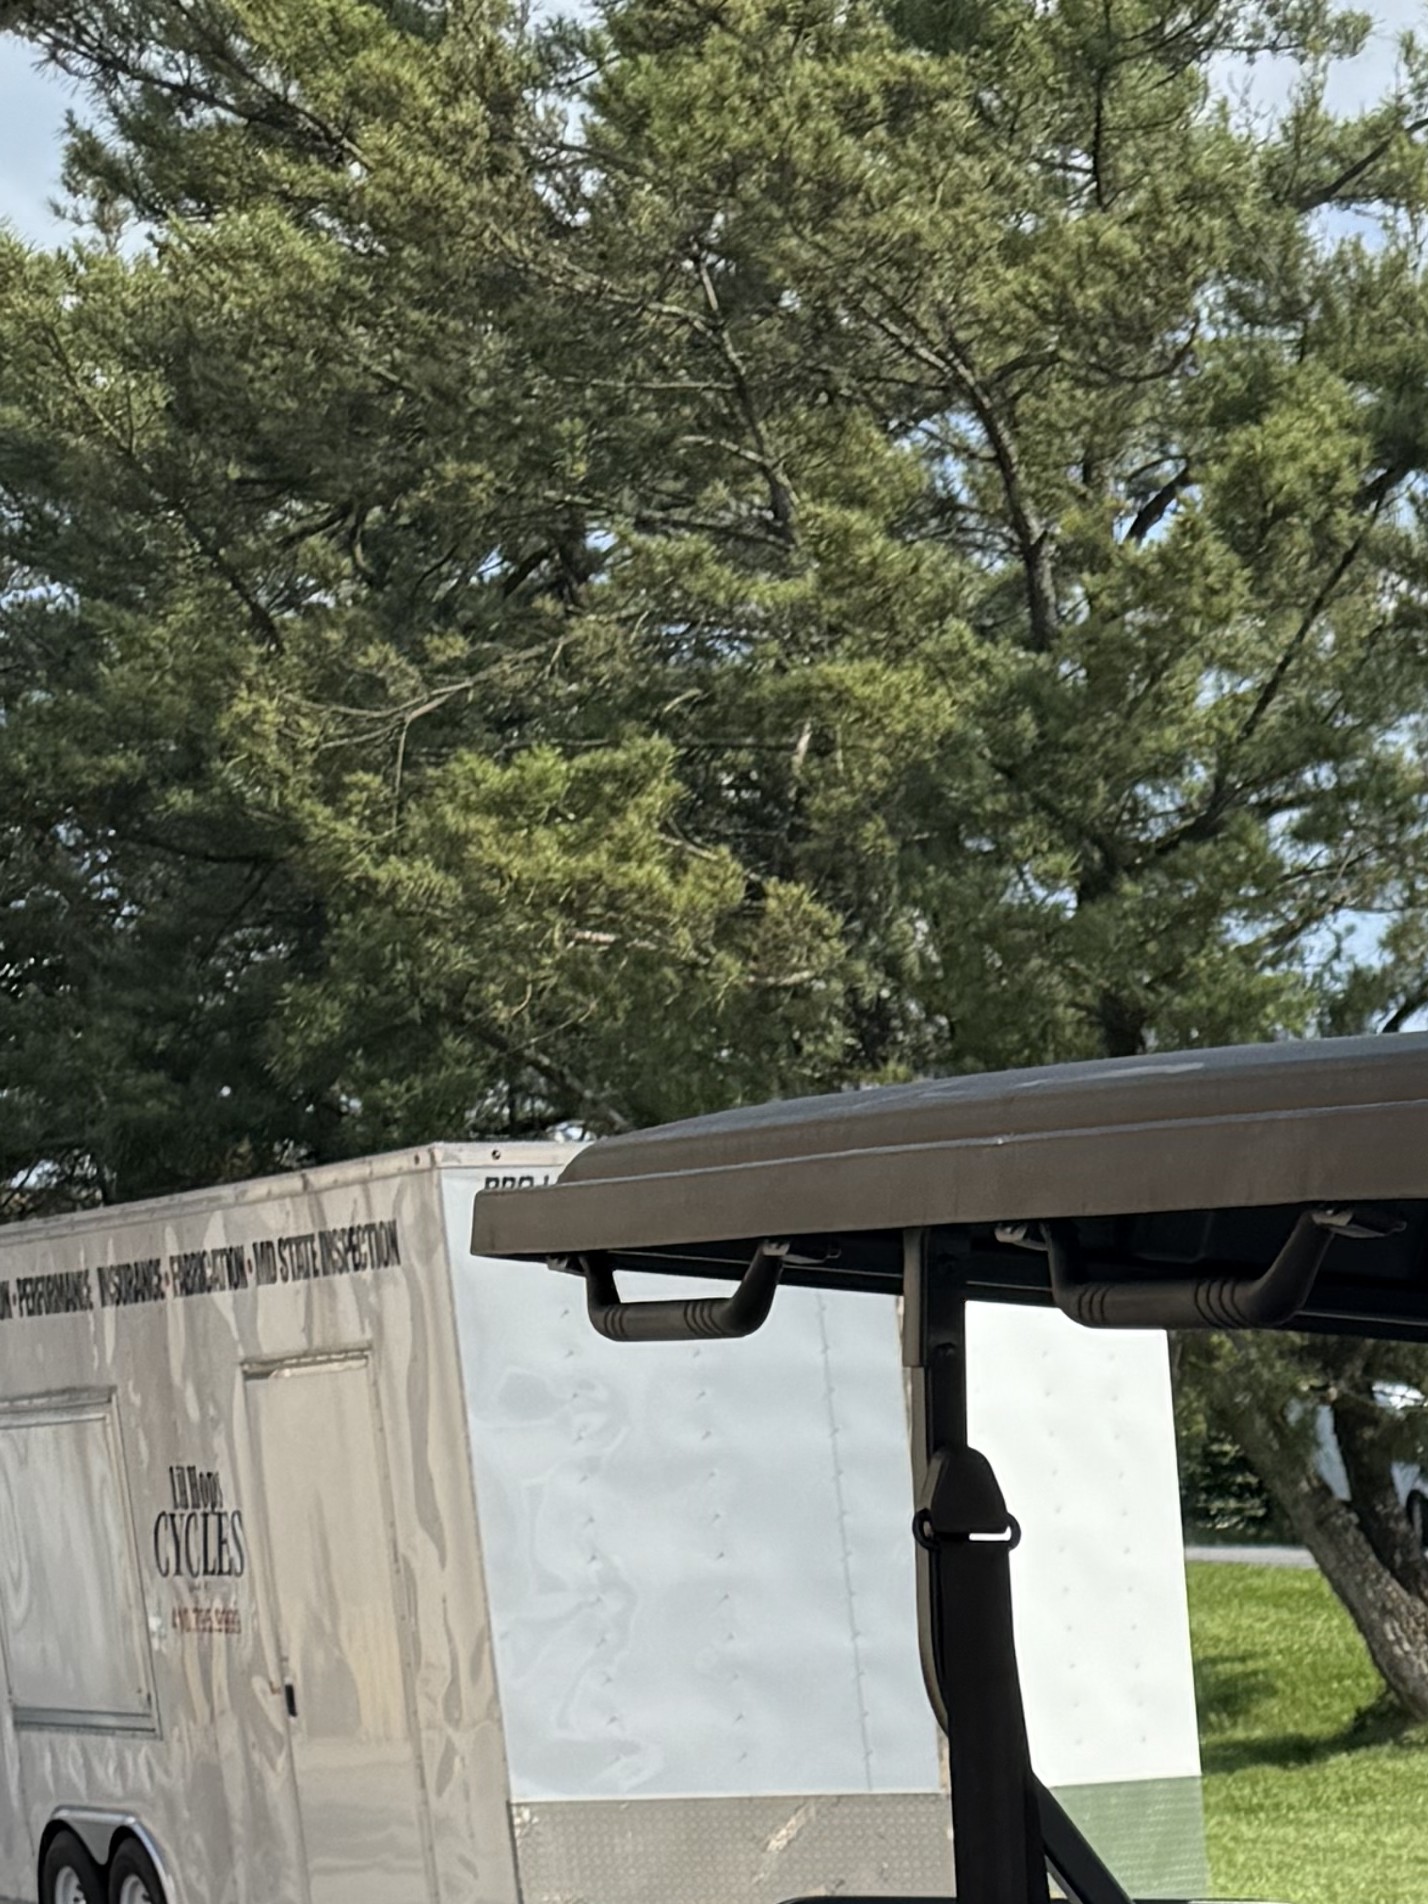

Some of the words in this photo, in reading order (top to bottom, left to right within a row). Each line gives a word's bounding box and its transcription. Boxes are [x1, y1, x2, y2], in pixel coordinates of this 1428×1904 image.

[277, 1232, 320, 1283] STATE
[319, 1219, 401, 1276] INSPECTION
[153, 1509, 246, 1579] CYCLES
